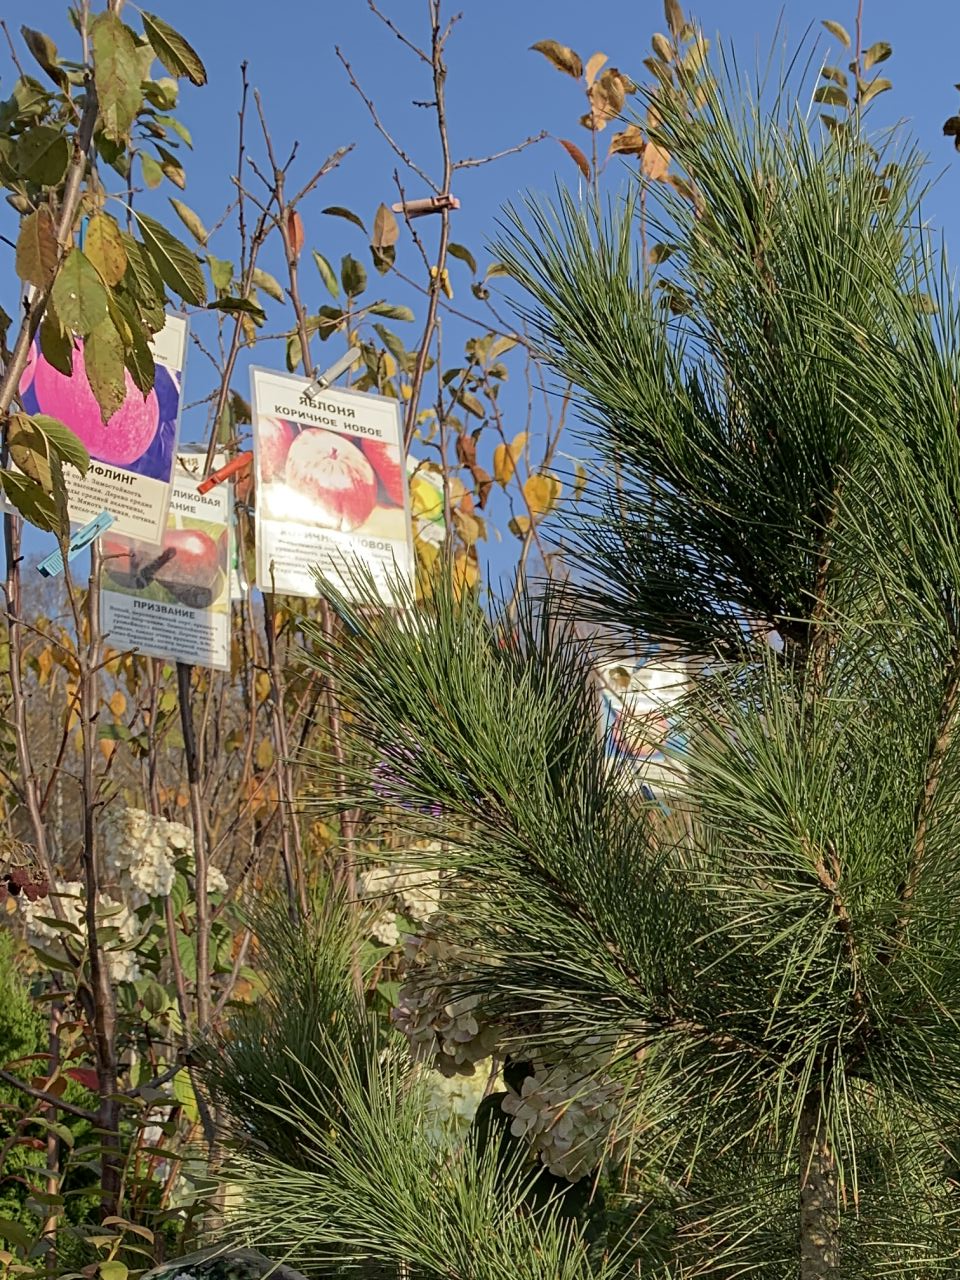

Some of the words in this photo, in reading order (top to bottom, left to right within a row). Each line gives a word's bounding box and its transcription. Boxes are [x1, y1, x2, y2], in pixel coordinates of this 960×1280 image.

[299, 396, 356, 418] ЯБЛОНЯ
[274, 404, 338, 427] КОРИЧНОЕ
[343, 421, 383, 437] НОВОЕ
[173, 489, 221, 507] ЛИКОВАЯ
[133, 599, 196, 620] ПРИЗВАНИЕ
